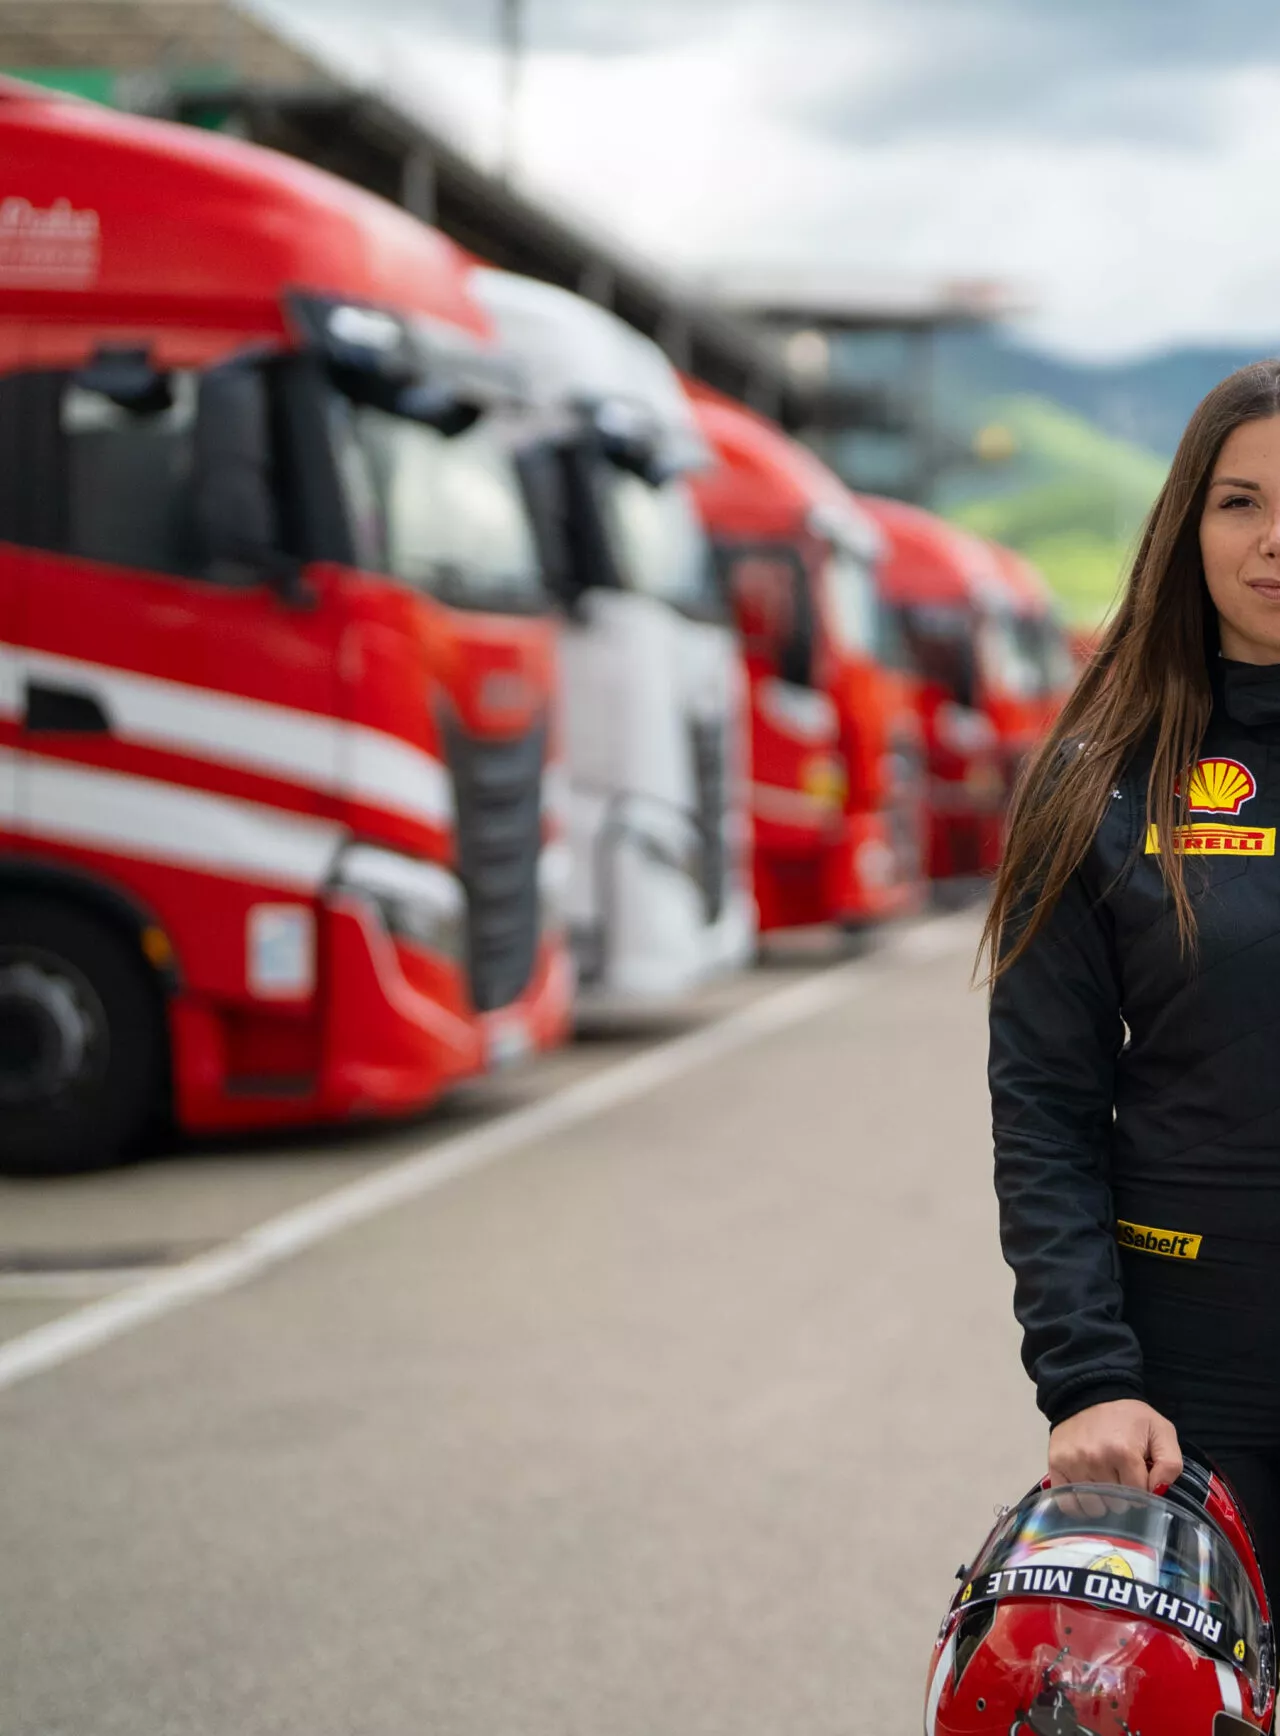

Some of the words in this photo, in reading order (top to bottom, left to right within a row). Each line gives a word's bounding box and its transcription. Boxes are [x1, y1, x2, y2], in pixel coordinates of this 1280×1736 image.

[1158, 829, 1265, 851] IRELLI
[1123, 1226, 1191, 1256] Sabelt
[986, 1568, 1073, 1594] MILLE
[1084, 1574, 1222, 1643] RICHARD
